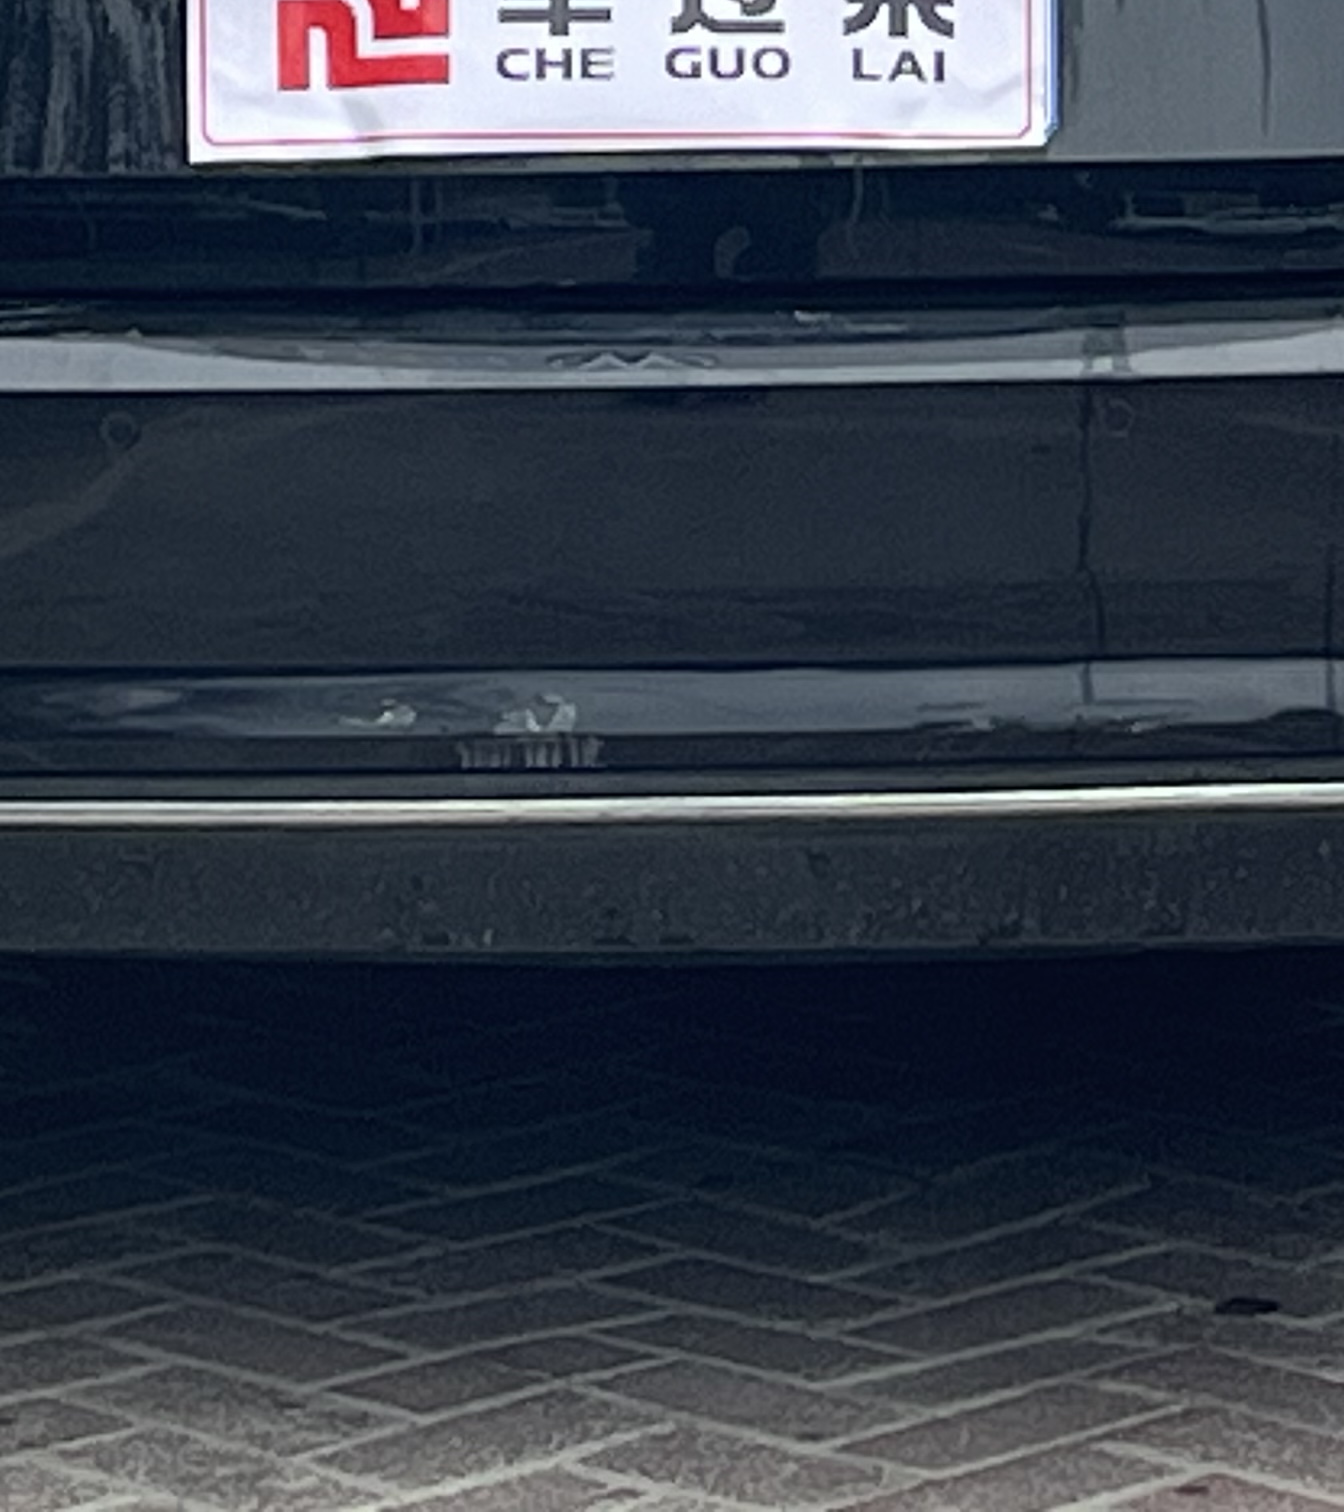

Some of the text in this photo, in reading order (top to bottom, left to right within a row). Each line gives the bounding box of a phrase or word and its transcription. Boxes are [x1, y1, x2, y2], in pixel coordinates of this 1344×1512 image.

[496, 45, 947, 83] CHE GUO LAI
